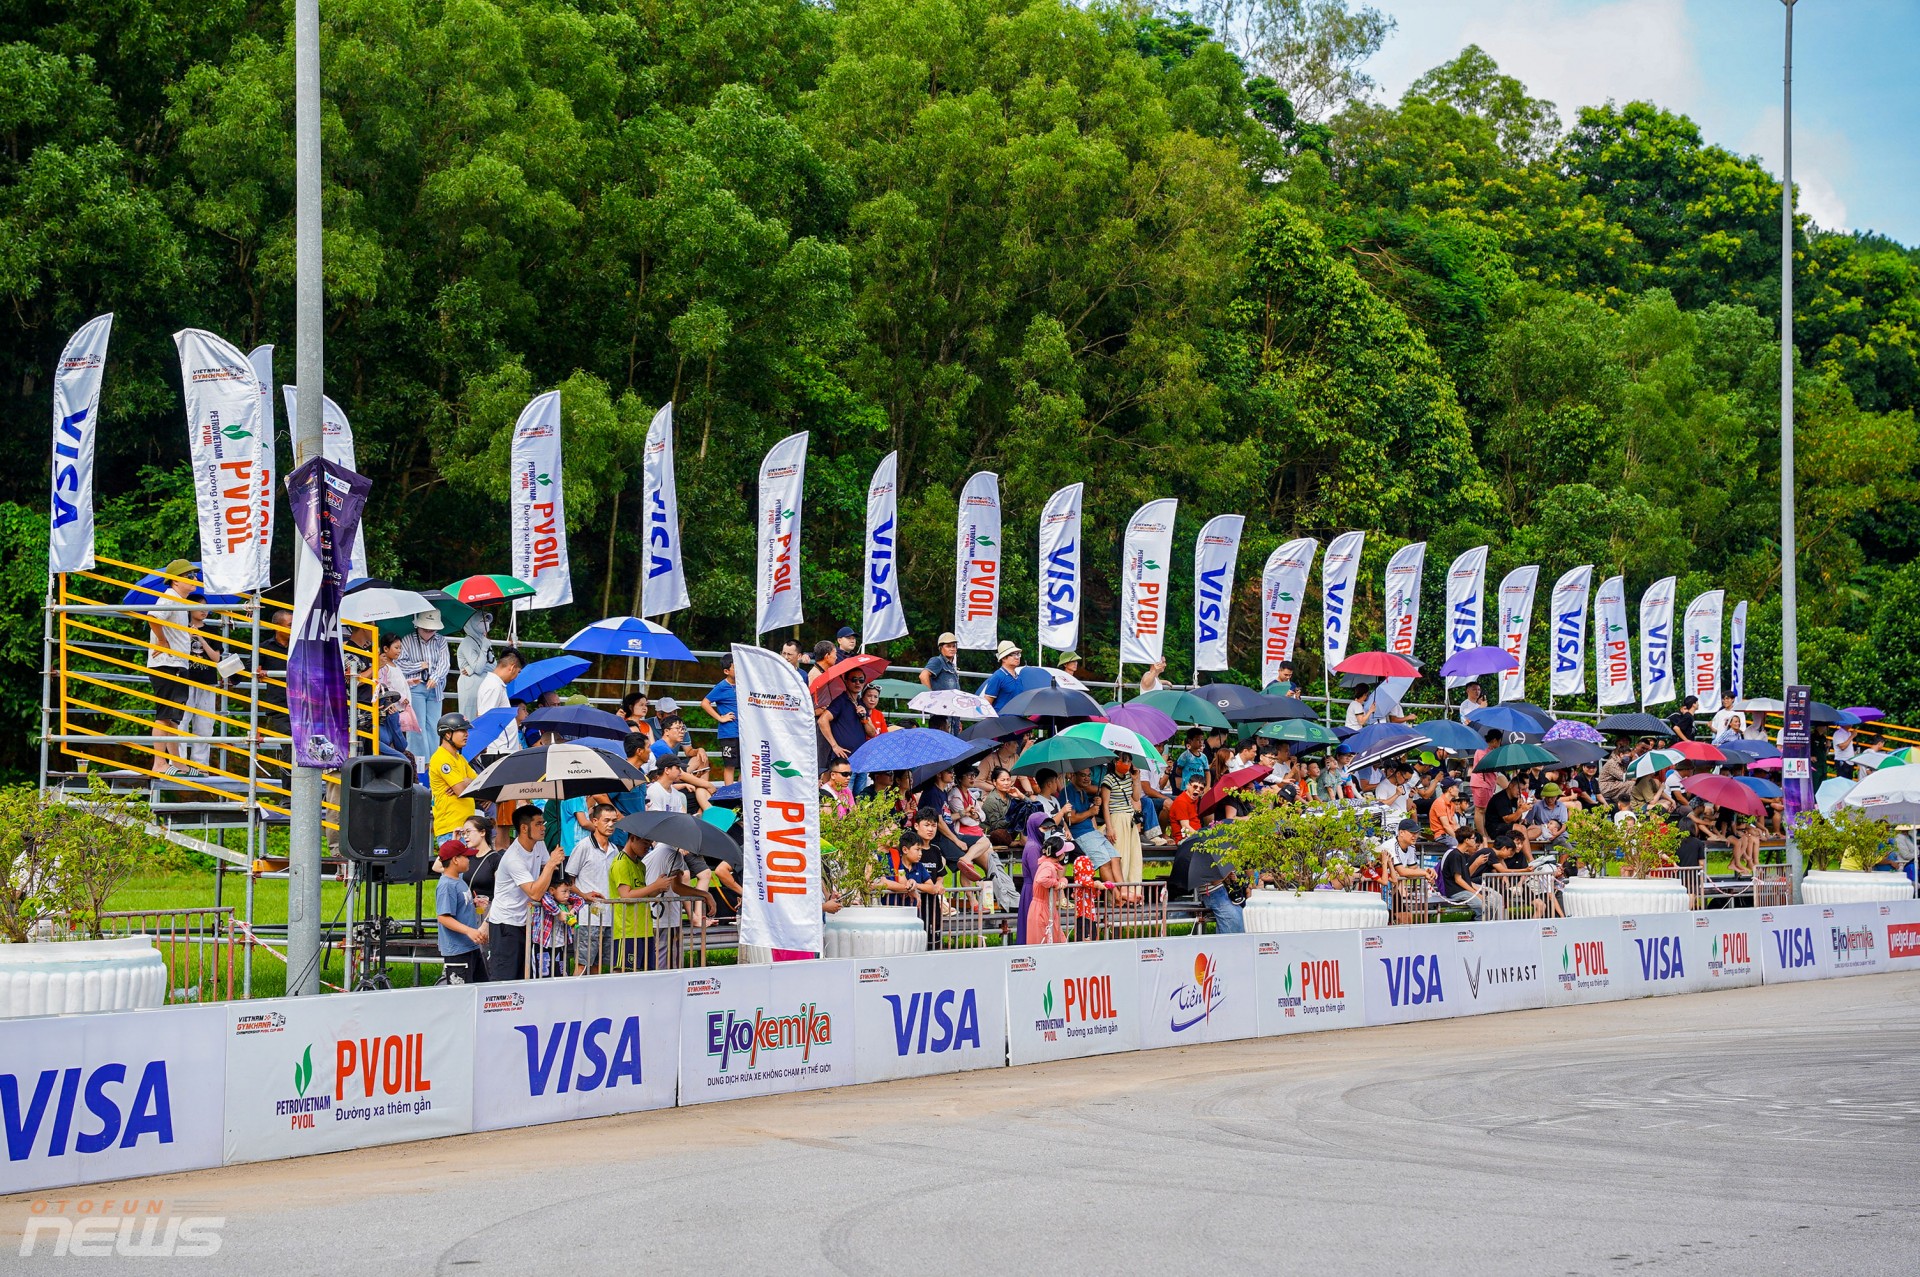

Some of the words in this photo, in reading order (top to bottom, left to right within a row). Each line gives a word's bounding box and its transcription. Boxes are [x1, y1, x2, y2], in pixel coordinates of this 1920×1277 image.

[202, 425, 210, 447] PVOIL
[211, 410, 223, 459] PETROVIETNAM
[52, 407, 90, 529] VISA
[208, 464, 218, 498] Đường
[212, 499, 218, 511] xa
[212, 512, 222, 536] thêm
[220, 460, 254, 553] PVOIL
[533, 501, 559, 577] PVOIL
[773, 532, 792, 602] PVOIL
[871, 511, 894, 613] VISA
[1047, 536, 1075, 626] VISA
[967, 560, 996, 621] PVOIL
[1136, 582, 1160, 639] PVOIL
[1199, 561, 1227, 643] VISA
[1265, 612, 1292, 665] PVOIL
[1556, 603, 1582, 673] VISA
[1648, 620, 1668, 685] VISA
[1608, 641, 1628, 686] PVOIL
[1696, 652, 1714, 695] PVOIL
[748, 696, 785, 706] GYMKHANA
[750, 691, 776, 700] VIETNAM
[751, 754, 760, 778] PVOIL
[761, 740, 771, 796] PETROVIETNAM
[752, 800, 762, 836] Đường
[754, 838, 760, 851] xa
[766, 800, 807, 903] PVOIL
[1574, 941, 1608, 977] PVOIL
[1634, 936, 1684, 980] VISA
[1722, 932, 1750, 964] PVOIL
[1772, 928, 1816, 968] VISA
[1831, 924, 1874, 961] Ekokemika
[1301, 960, 1344, 1001] PVOIL
[1380, 954, 1444, 1006] VISA
[1486, 964, 1536, 984] VINFAST
[1064, 975, 1117, 1022] PVOIL
[236, 1022, 272, 1030] GYMKHANA
[707, 1002, 832, 1072] Ekokemika
[882, 988, 980, 1056] VISA
[336, 1033, 430, 1101] PVOIL
[514, 1016, 642, 1096] VISA
[708, 1076, 724, 1086] DUNG
[754, 1072, 762, 1080] XE
[762, 1069, 782, 1080] KHÔNG
[0, 1060, 174, 1161] VISA
[276, 1095, 330, 1116] PETROVIETNAM
[291, 1113, 315, 1130] PVOIL
[336, 1106, 370, 1121] Đường
[373, 1104, 385, 1116] xa
[388, 1100, 411, 1115] thêm
[414, 1096, 431, 1114] gần
